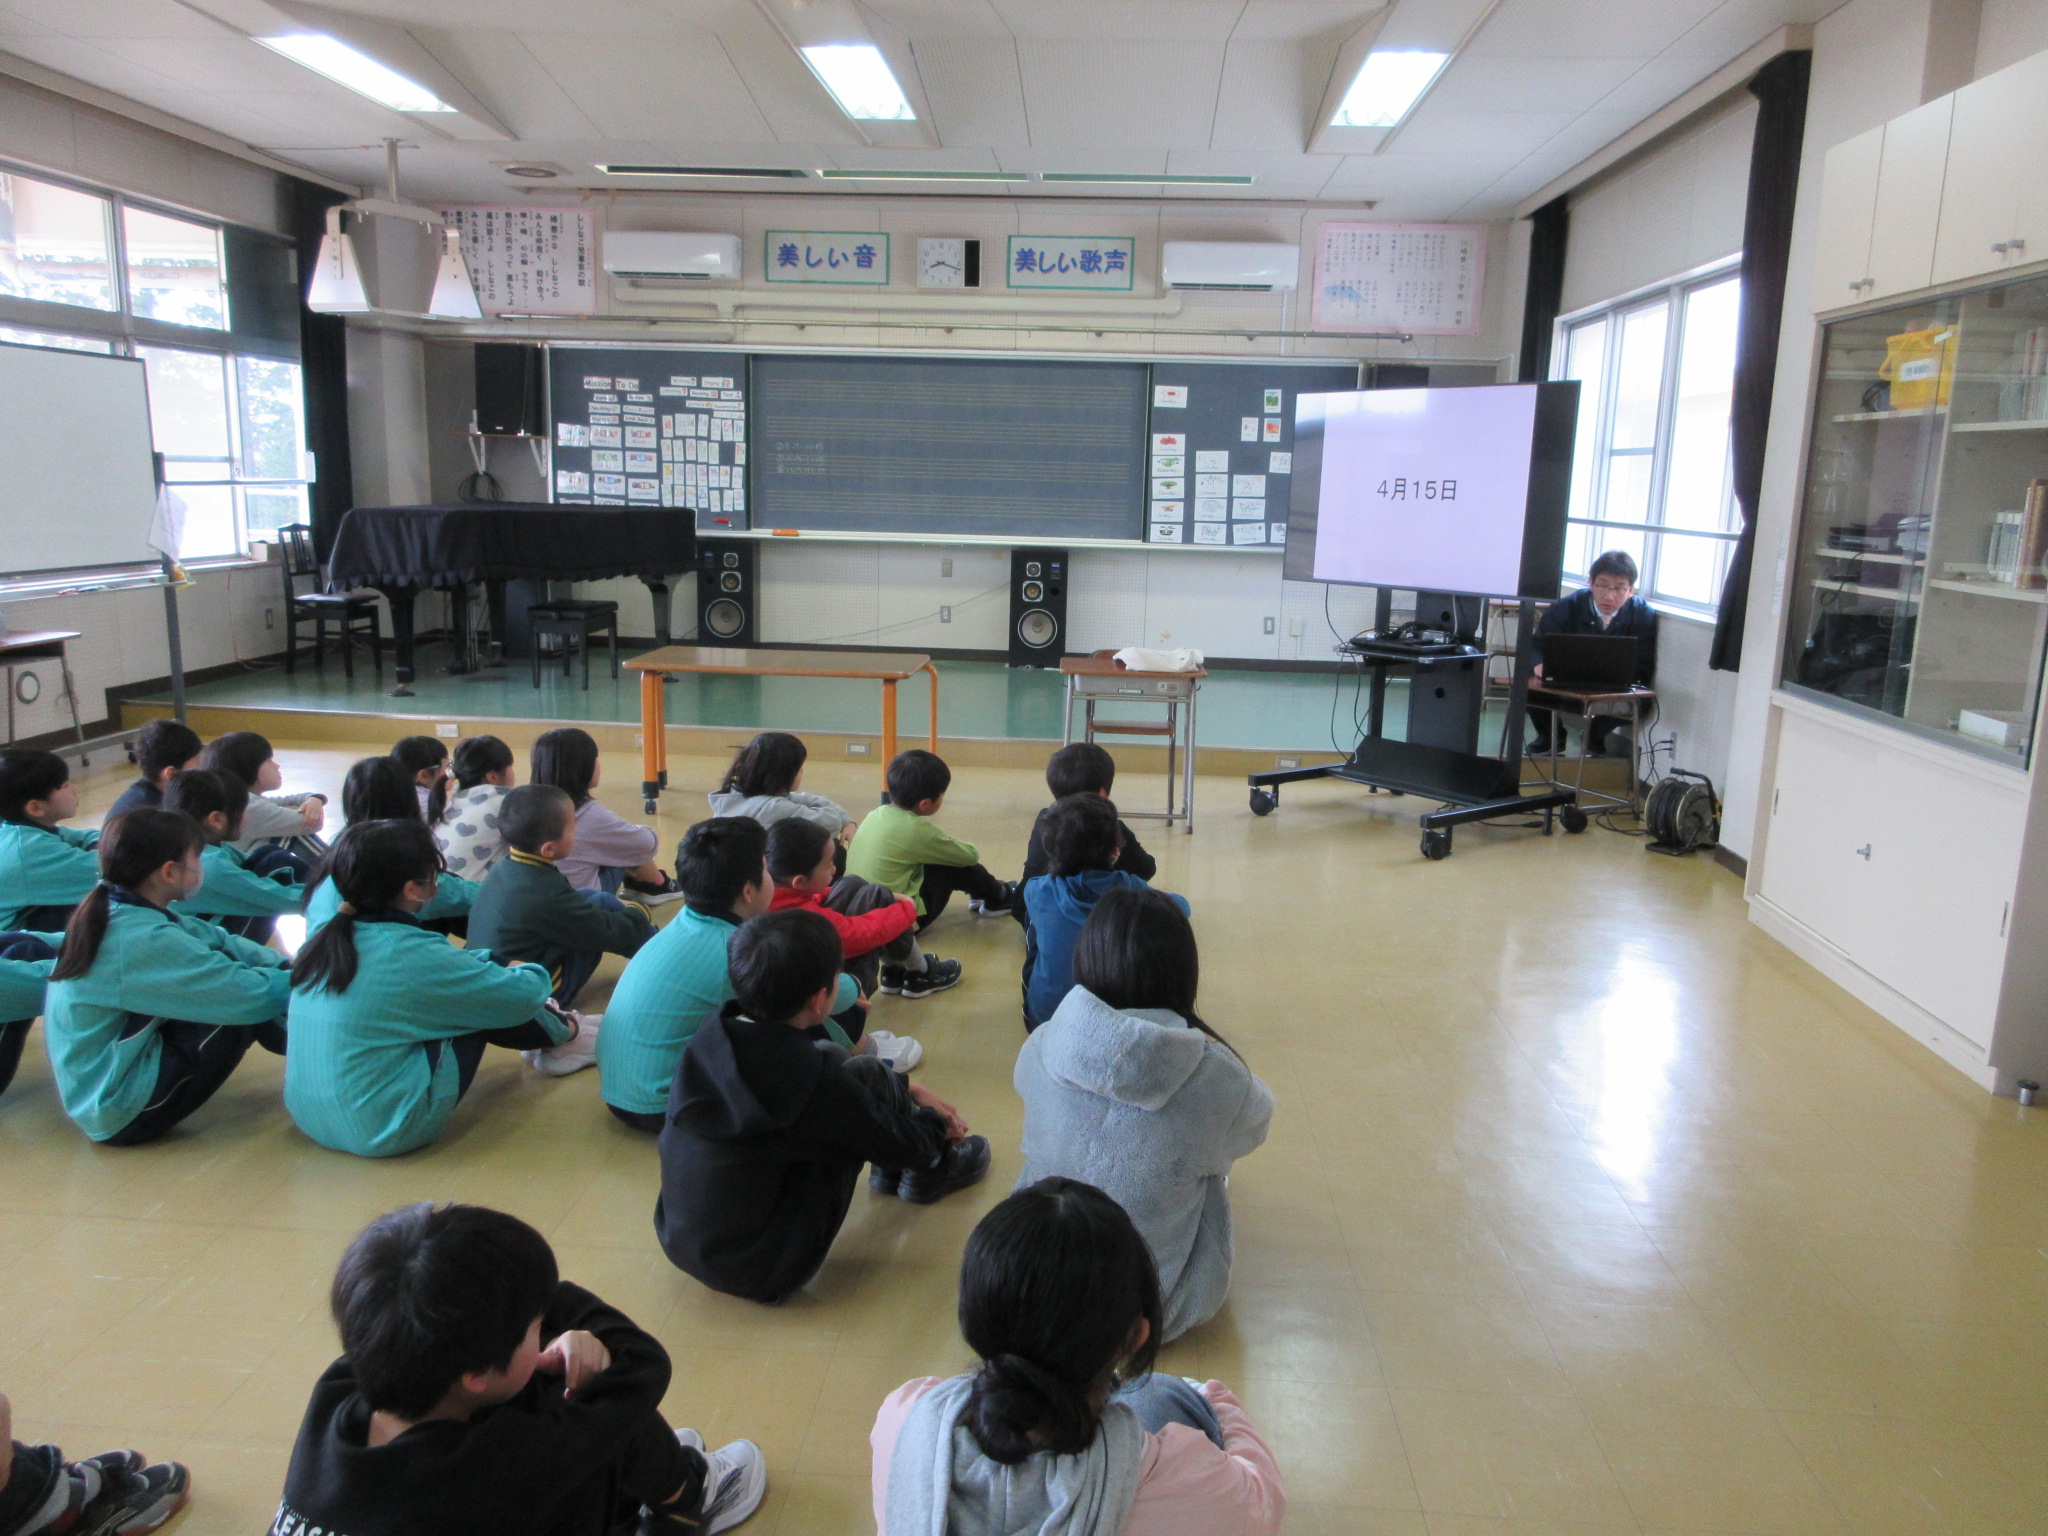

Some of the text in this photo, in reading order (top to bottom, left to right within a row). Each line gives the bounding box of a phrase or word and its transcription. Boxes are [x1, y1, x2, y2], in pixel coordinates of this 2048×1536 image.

[777, 244, 878, 270] 美しい音
[1014, 248, 1128, 274] 美しい歌声
[584, 379, 611, 388] Mission
[615, 380, 639, 390] To Do
[1376, 478, 1457, 501] 4月15日
